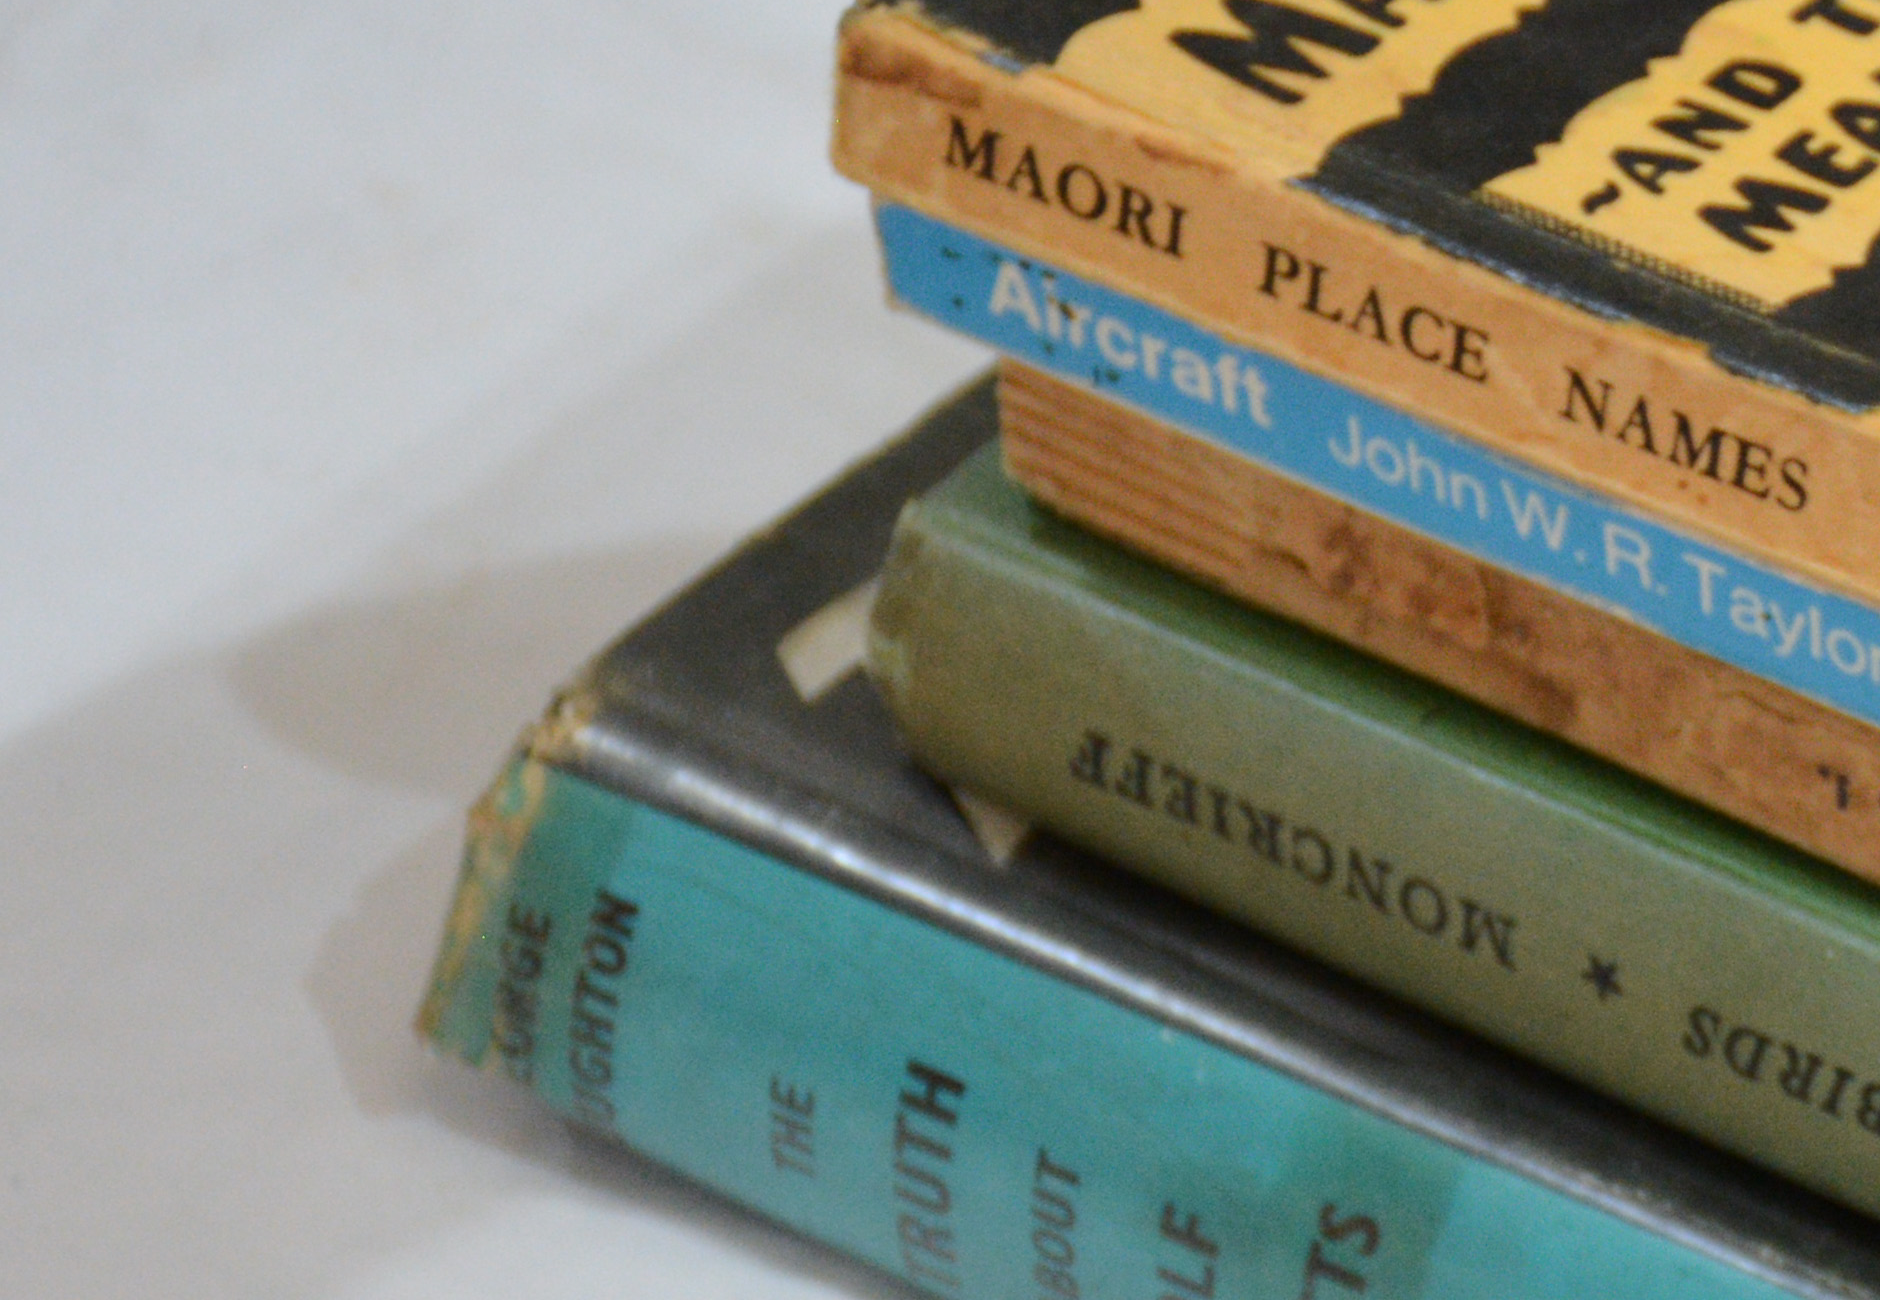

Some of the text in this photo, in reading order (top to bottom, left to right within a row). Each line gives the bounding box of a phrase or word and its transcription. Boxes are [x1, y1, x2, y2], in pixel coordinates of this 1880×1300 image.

[944, 115, 1188, 260] MAORI
[1260, 240, 1490, 384] PLACE
[1558, 367, 1811, 512] NAMES
[988, 254, 1275, 431] Aircraft
[1328, 414, 1488, 521] John
[1067, 728, 1519, 971] MONCRIEFF
[769, 1073, 815, 1178] THE
[894, 1058, 966, 1290] TRUTH
